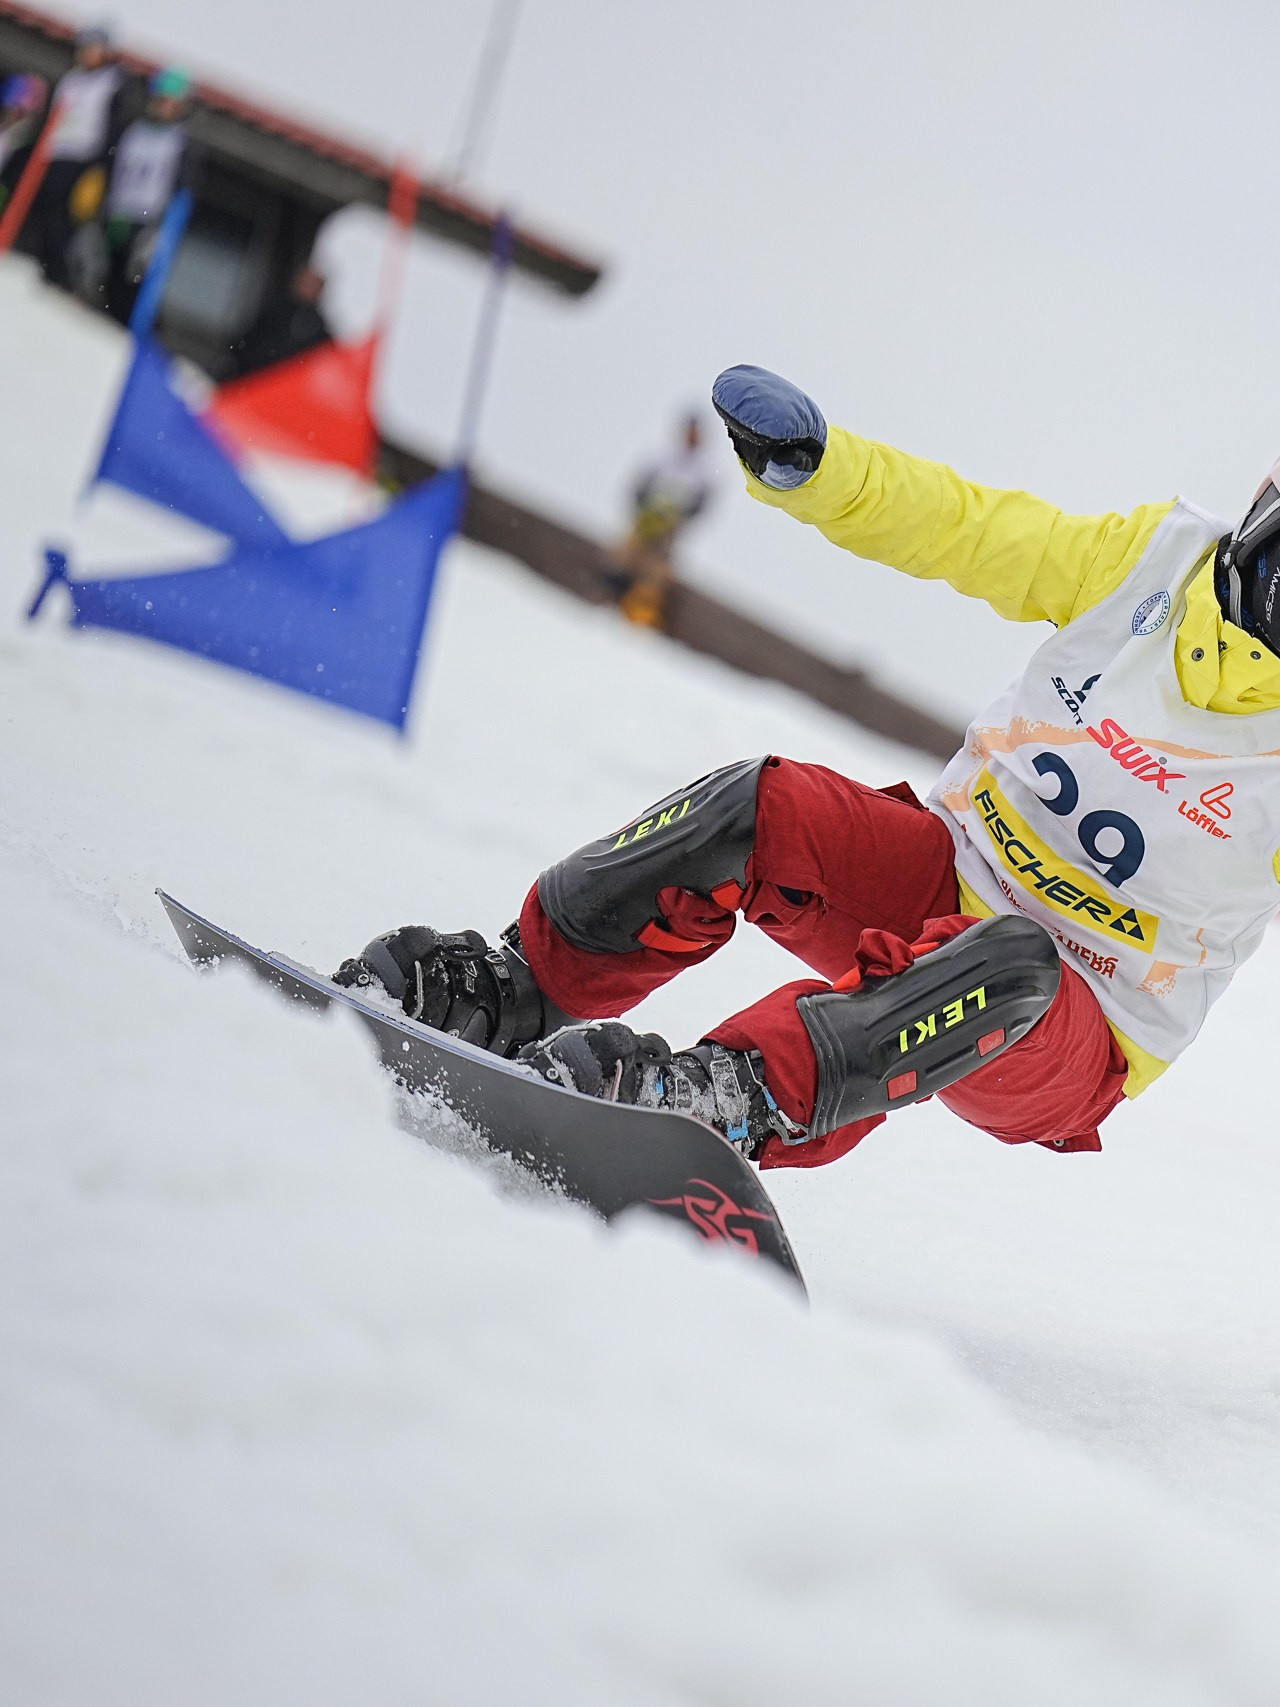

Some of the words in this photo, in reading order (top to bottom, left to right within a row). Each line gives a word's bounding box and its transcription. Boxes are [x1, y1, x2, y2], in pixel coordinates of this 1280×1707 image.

[611, 798, 691, 851] LEKI
[974, 788, 1112, 925] FISCHER
[899, 985, 987, 1054] LEKI
